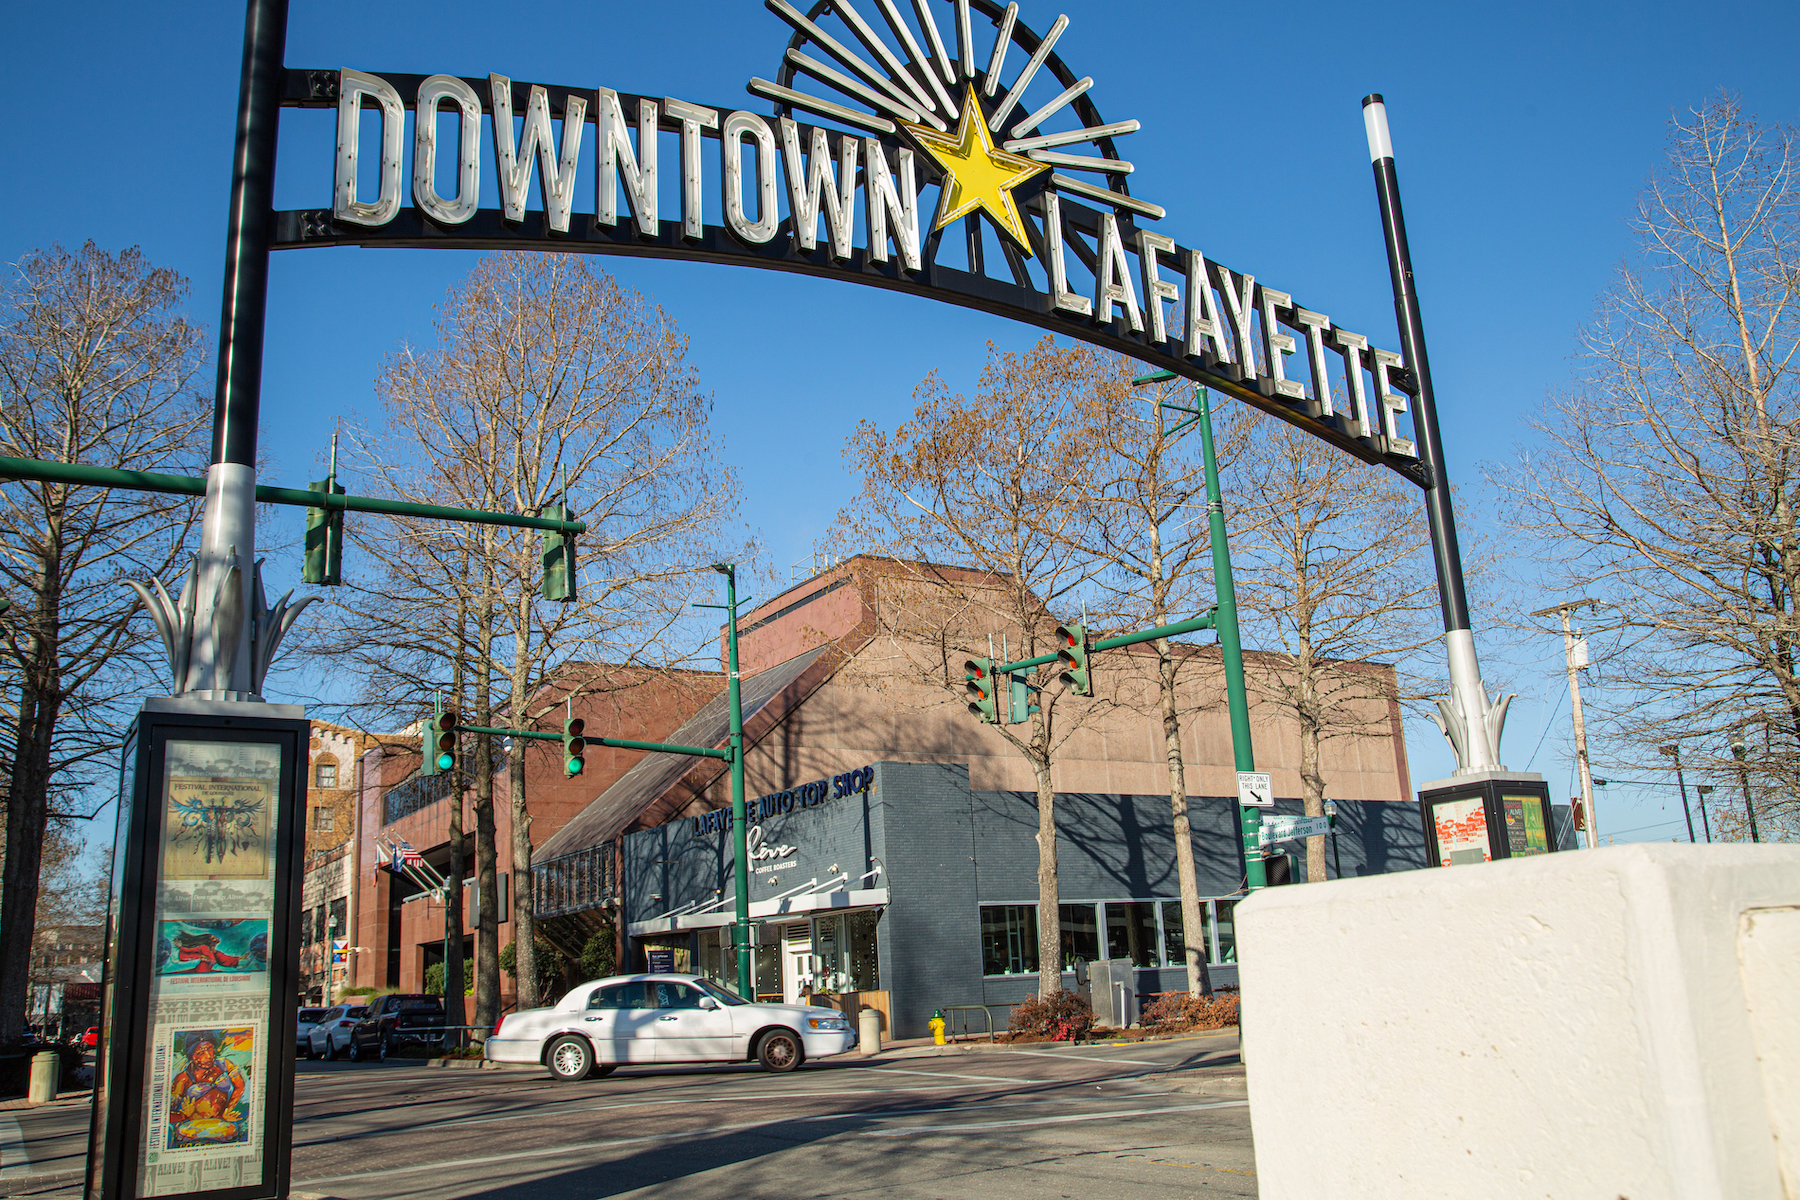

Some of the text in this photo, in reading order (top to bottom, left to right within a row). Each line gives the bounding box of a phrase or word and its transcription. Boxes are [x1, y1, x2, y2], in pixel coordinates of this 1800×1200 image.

[333, 66, 1417, 457] DOWNTOWN LAFAYETTE
[174, 783, 262, 792] FESTIVAL INTERNATIONAL
[693, 766, 874, 836] LAFAYEE AUTO TOP SHOP
[1288, 826, 1313, 837] Jefferson
[747, 825, 797, 872] Rêve
[755, 860, 797, 875] COFFEE ROASTERS
[170, 977, 190, 985] FESTIVAL
[190, 976, 222, 984] INTERNATIONAL
[154, 1045, 167, 1073] LOUISIANE
[154, 1073, 165, 1082] DE
[151, 1081, 164, 1125] INTERNATIONAL
[149, 1125, 161, 1149] FESTIVAL
[157, 1161, 185, 1176] ALIVE!
[203, 1156, 230, 1171] ALIVE!
